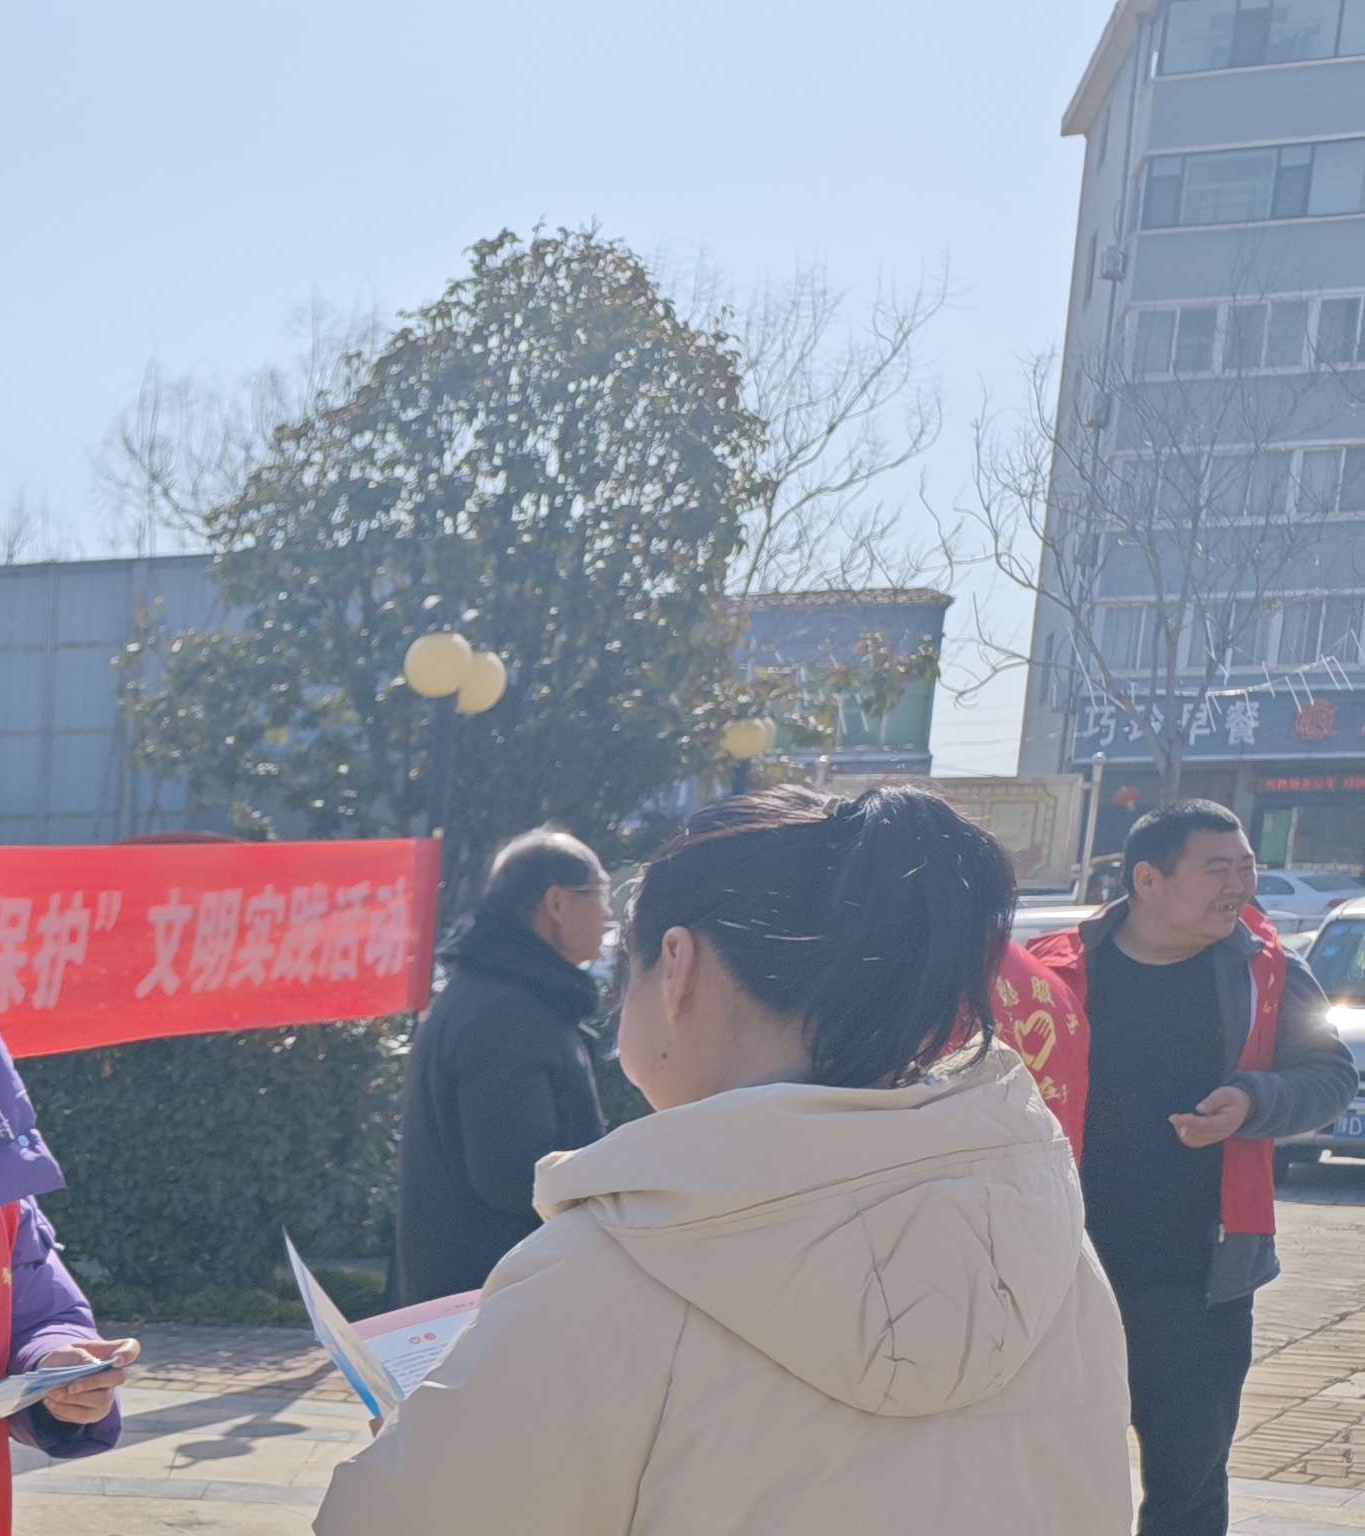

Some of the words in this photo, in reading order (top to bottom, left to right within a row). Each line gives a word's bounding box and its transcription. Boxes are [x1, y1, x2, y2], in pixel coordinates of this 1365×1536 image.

[135, 875, 409, 1000] 文明实践活动
